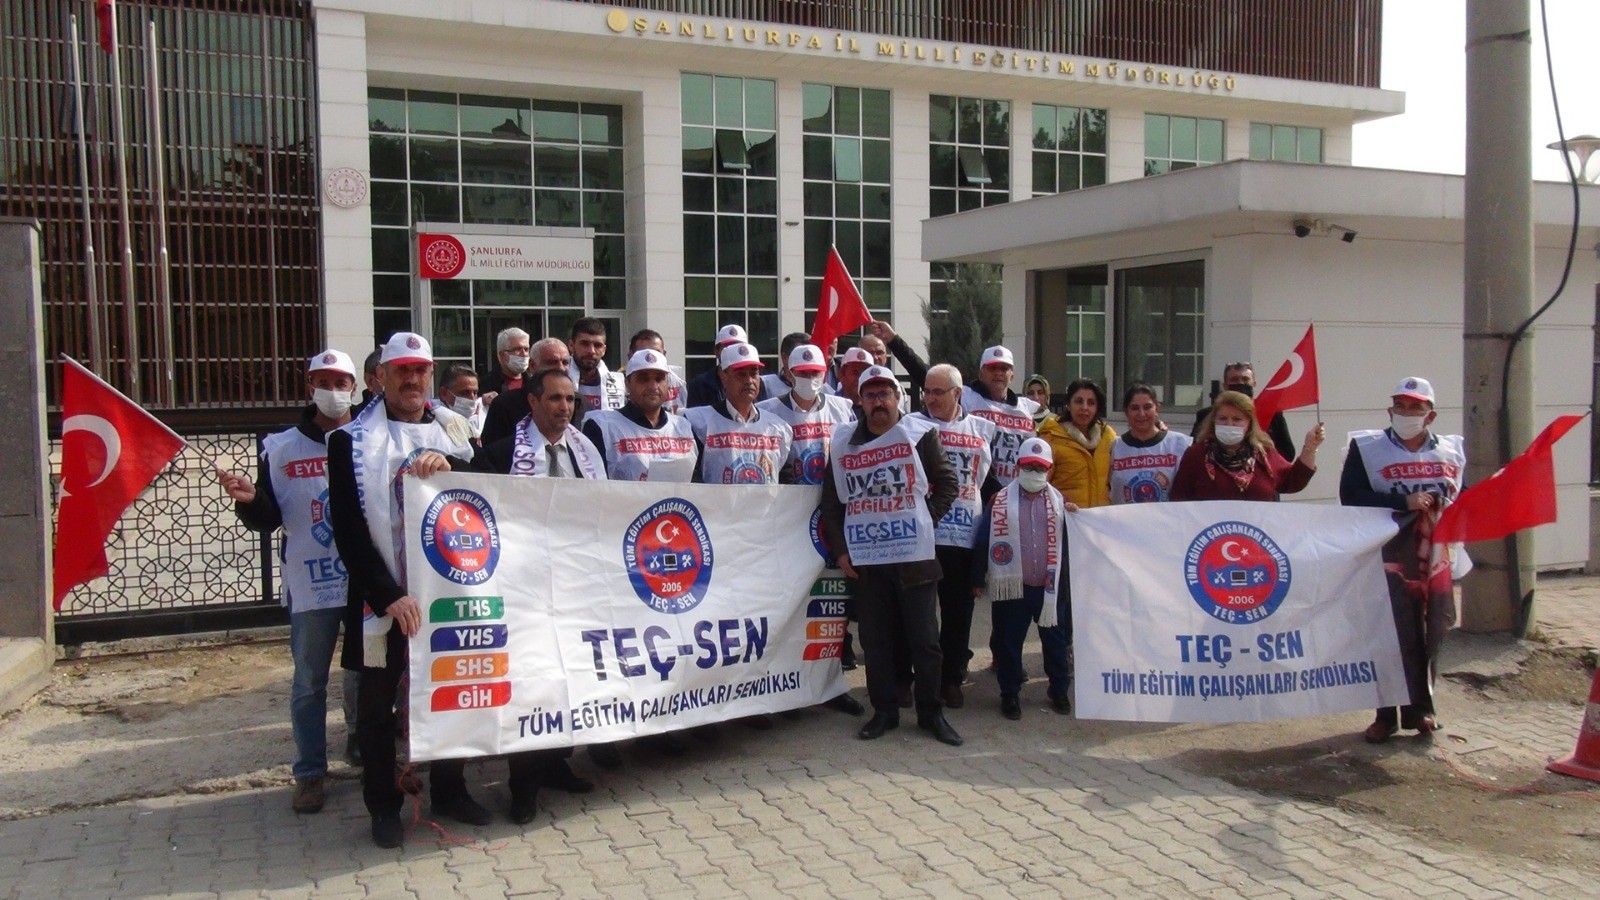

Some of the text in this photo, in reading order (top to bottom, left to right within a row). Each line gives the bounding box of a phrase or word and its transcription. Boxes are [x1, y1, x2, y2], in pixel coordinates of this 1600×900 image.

[634, 17, 822, 49] ŞANLIURFA
[836, 33, 860, 52] İL
[973, 49, 1075, 75] EĞİTİM
[1086, 62, 1237, 91] MÜDÜRLÜĞÜ
[470, 247, 522, 256] ŞANLIURFA
[470, 257, 477, 267] İL
[504, 258, 533, 268] EĞİTİM
[536, 260, 590, 269] MÜDÜRLÜĞÜ
[713, 435, 779, 447] EYLEMDEYİZ
[845, 444, 910, 468] EYLEMDEYİZ
[1113, 455, 1176, 469] EYLEMDEYİZ
[423, 493, 498, 547] TÜM EĞİTİM ÇALIŞANLARI SENDİKASI
[625, 502, 711, 568] TÜM EĞİTİM ÇALIŞANLARI SENDİKASI
[461, 558, 478, 566] 2006
[1187, 524, 1288, 585] TÜM EĞİTİM ÇALIŞANLARI SENDİKASI
[448, 567, 467, 584] TEÇ
[474, 568, 488, 582] SEN
[661, 582, 682, 593] 2006
[821, 580, 846, 593] THS
[650, 593, 668, 612] TEÇ
[677, 592, 696, 609] SEN
[820, 602, 846, 614] YHS
[1228, 595, 1255, 604] 2006
[455, 600, 491, 618] THS
[1213, 605, 1235, 622] TEÇ
[1245, 605, 1268, 620] SEN
[455, 628, 494, 647] YHS
[820, 623, 844, 636] SHS
[582, 616, 768, 681] TEÇ-SEN
[819, 643, 839, 658] GİH
[1176, 634, 1232, 668] TEÇ
[1257, 630, 1304, 662] SEN
[455, 657, 495, 677] SHS
[1101, 660, 1378, 701] TÜM EĞİTİM ÇALIŞANLARI SENDİKASI
[458, 685, 492, 708] GİH
[518, 670, 800, 738] TÜM EĞİTİM ÇALIŞANLARI SENDİKASI
